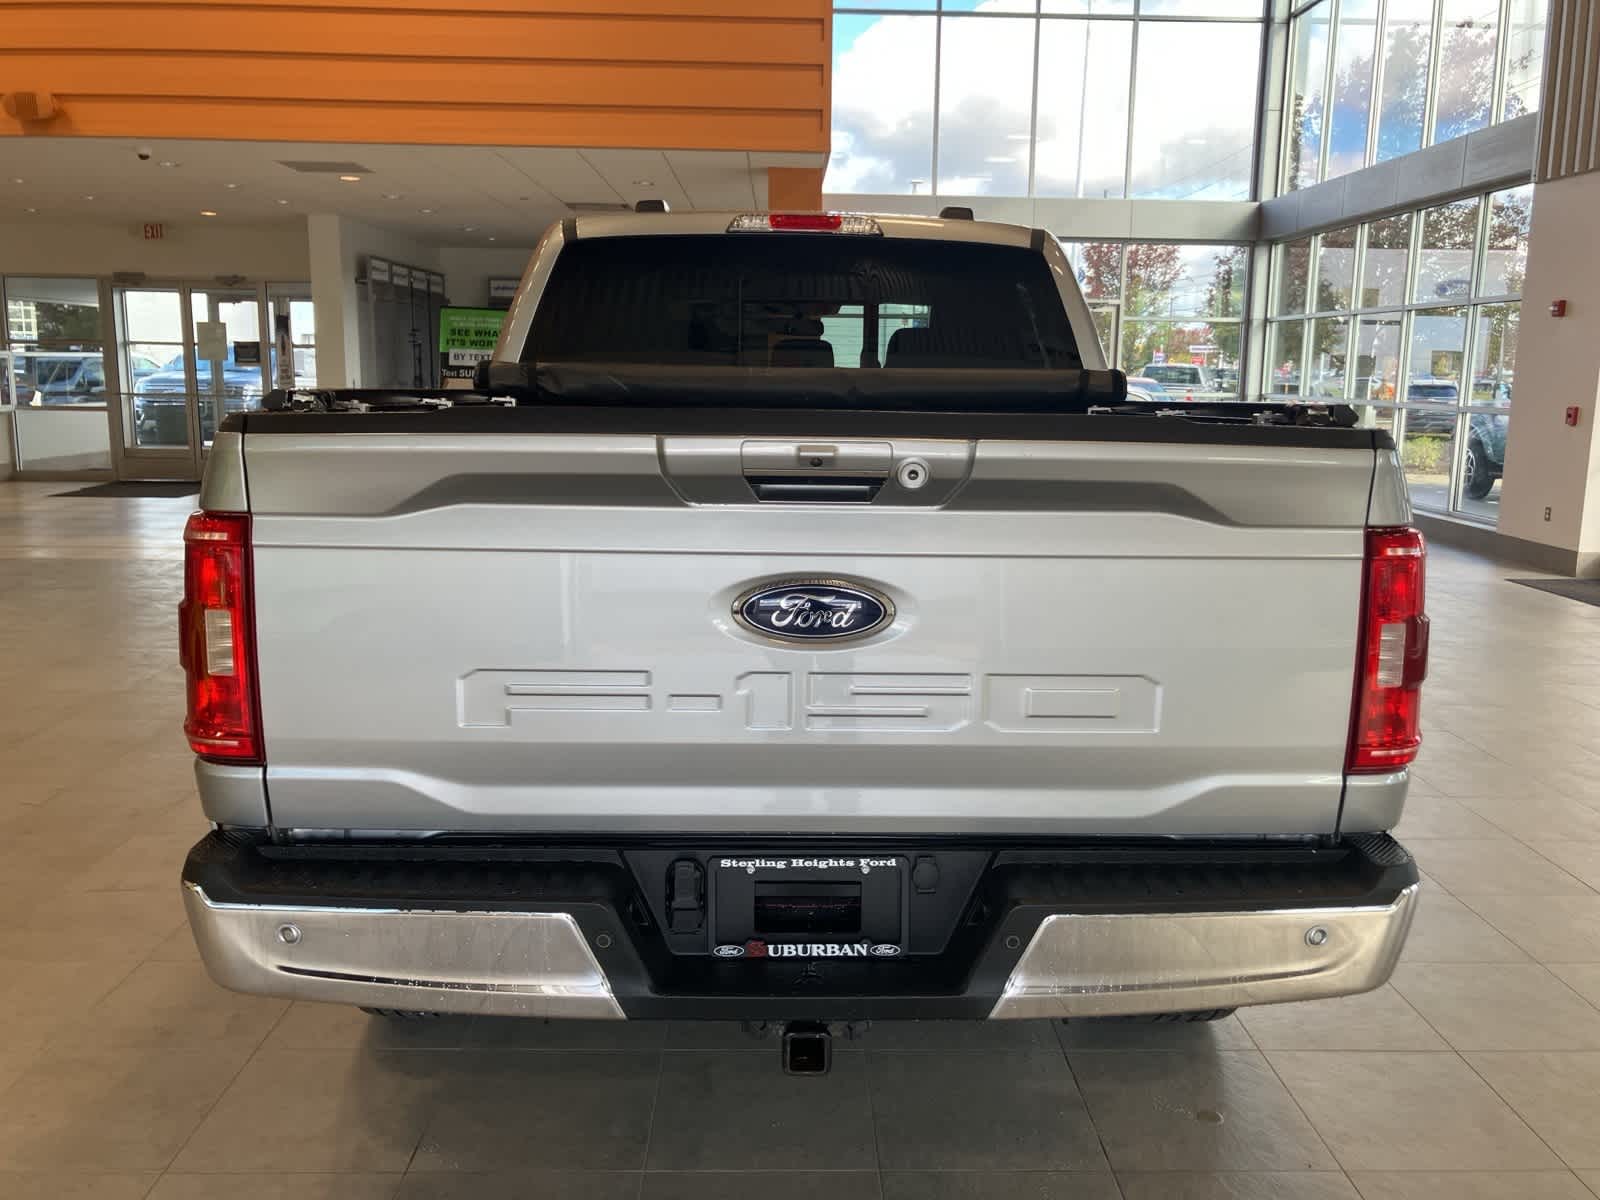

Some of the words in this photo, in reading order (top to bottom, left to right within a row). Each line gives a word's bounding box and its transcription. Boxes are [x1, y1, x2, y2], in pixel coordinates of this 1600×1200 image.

[144, 223, 164, 240] EXIT
[449, 328, 470, 336] SEE
[446, 338, 466, 346] IT'S
[453, 353, 466, 361] BY
[769, 594, 856, 631] Ford
[457, 668, 1163, 734] F-150
[720, 858, 787, 869] Sterling
[791, 858, 855, 869] Heights
[858, 858, 897, 868] Ford
[747, 941, 868, 957] SUBURBAN
